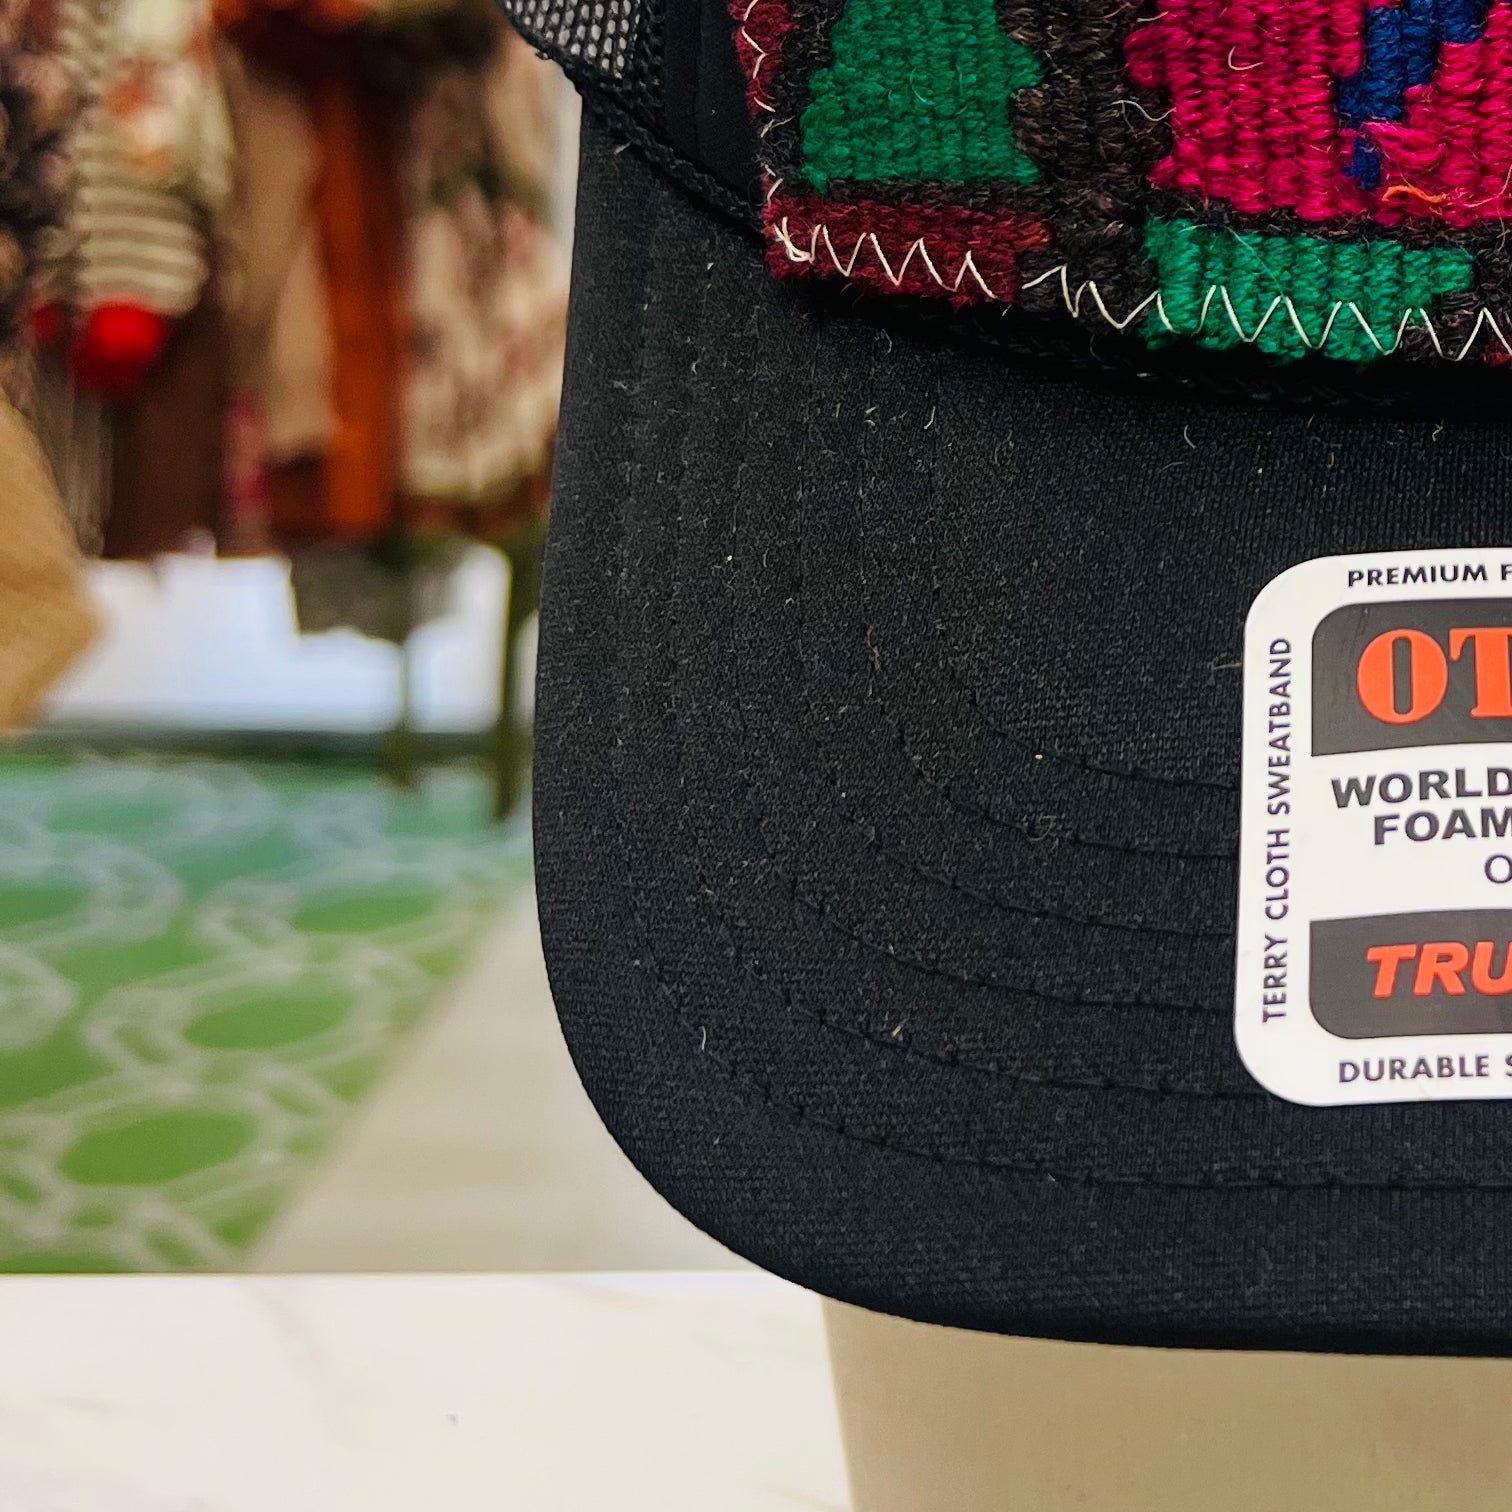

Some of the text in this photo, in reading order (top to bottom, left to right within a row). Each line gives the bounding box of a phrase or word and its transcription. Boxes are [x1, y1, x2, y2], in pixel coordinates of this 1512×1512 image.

[1347, 563, 1488, 587] PREMIUM
[1262, 638, 1291, 1022] TERRY CLOTH SWEATBAND
[1338, 1055, 1490, 1083] DURABLE
